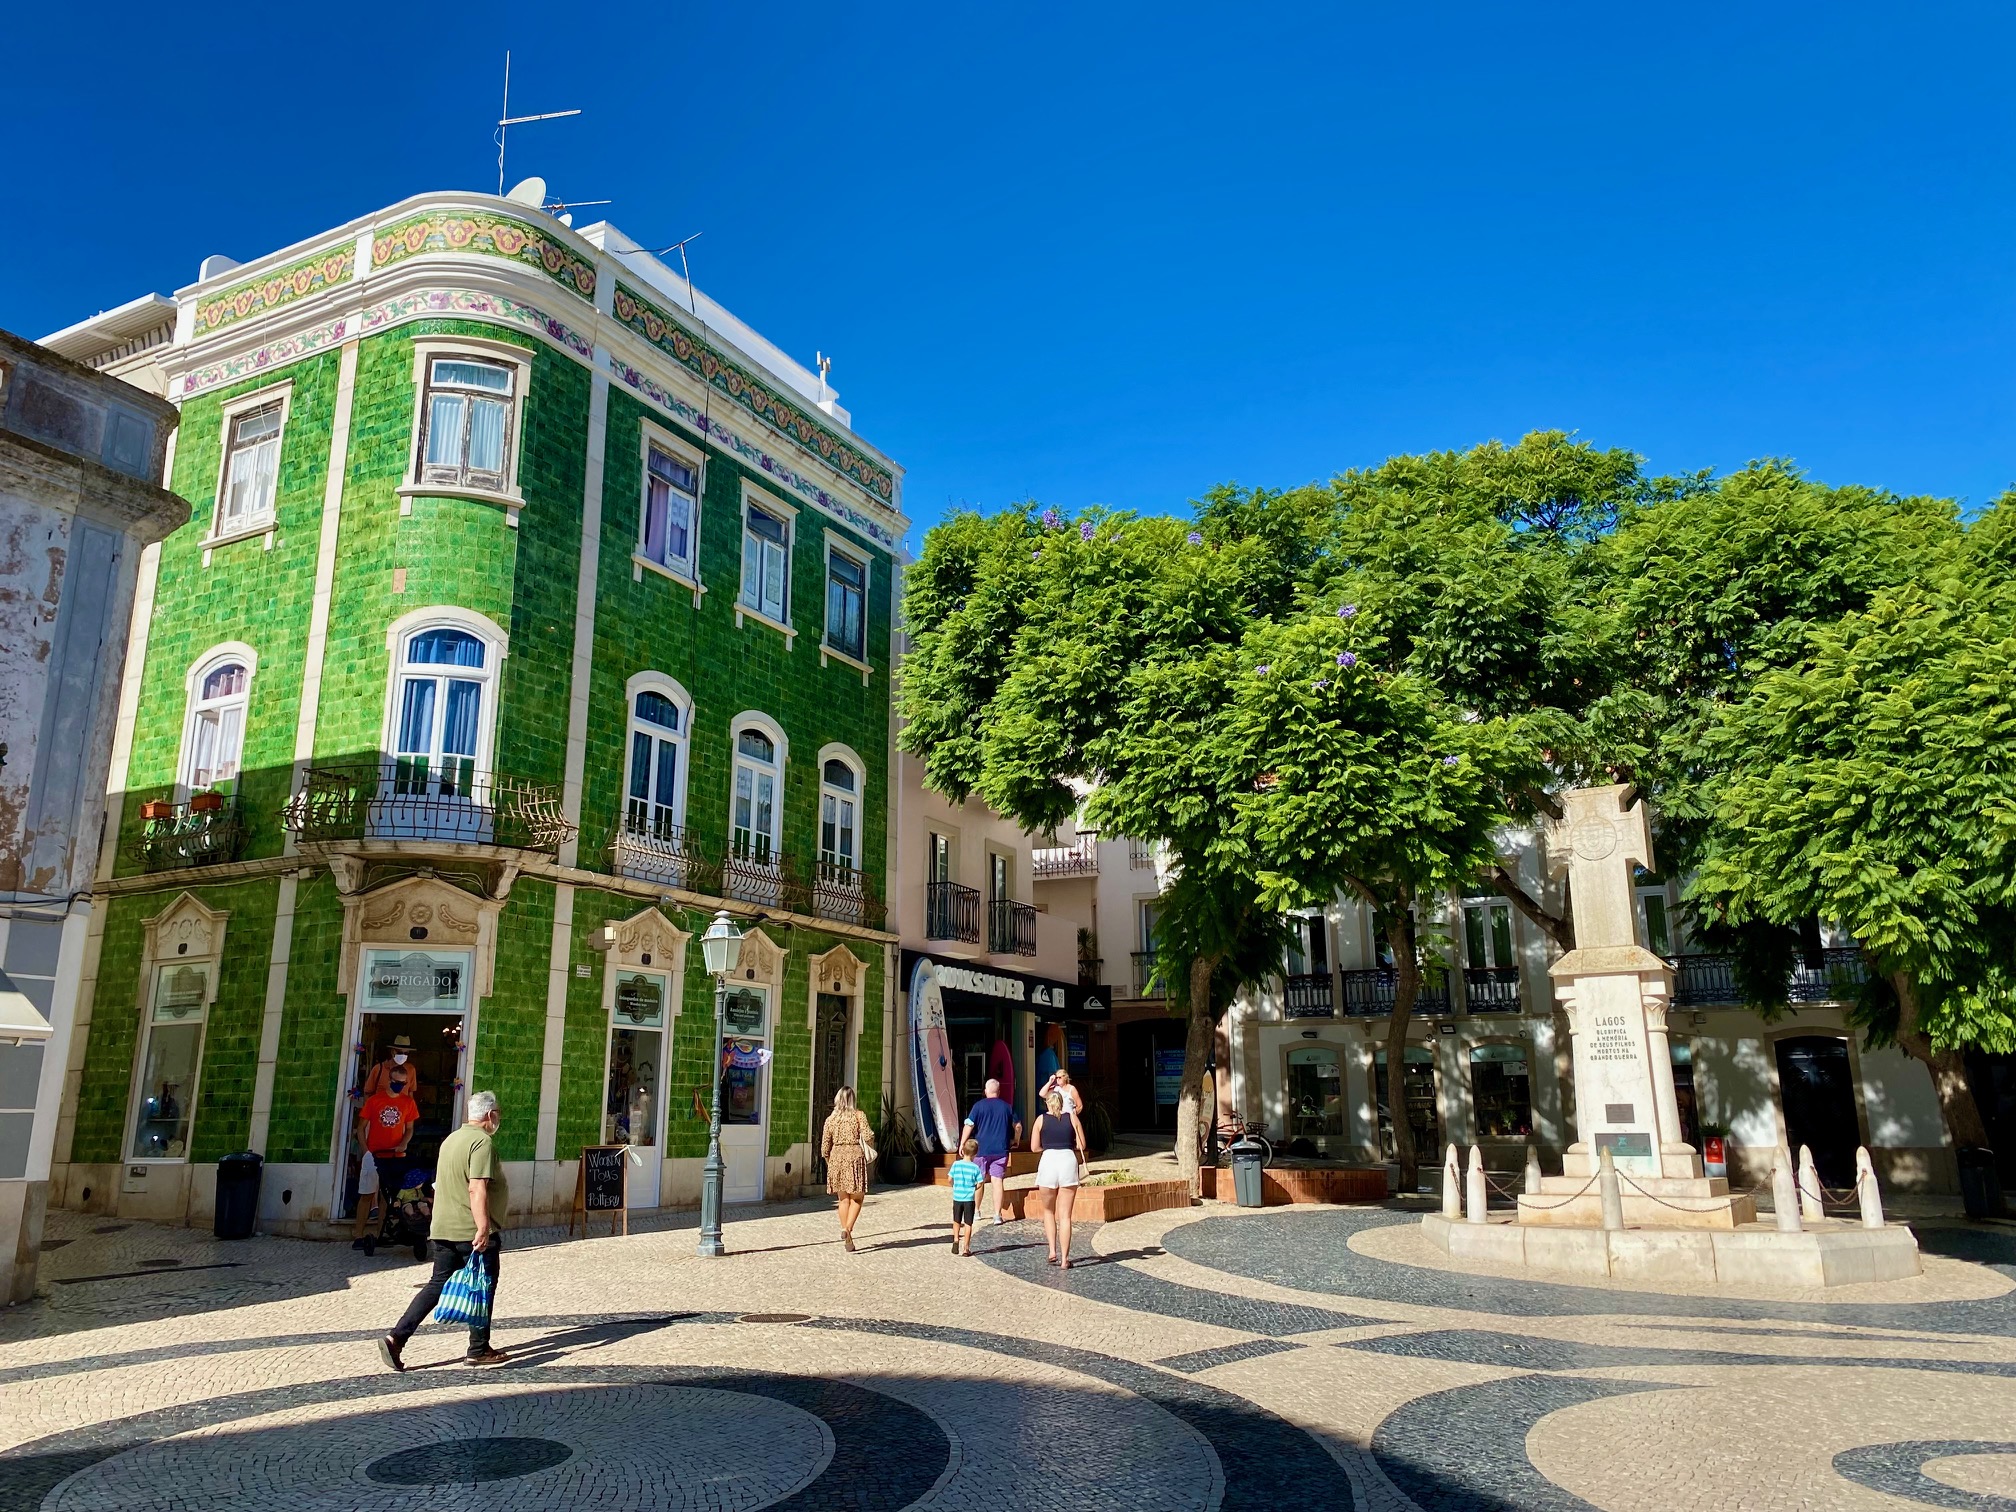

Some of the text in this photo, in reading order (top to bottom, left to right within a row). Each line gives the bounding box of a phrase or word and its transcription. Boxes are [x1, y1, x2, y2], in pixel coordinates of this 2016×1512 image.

[381, 974, 451, 987] OBRIGADO
[933, 964, 1025, 1001] QUIKSILVER
[1595, 1016, 1626, 1027] LAGOS
